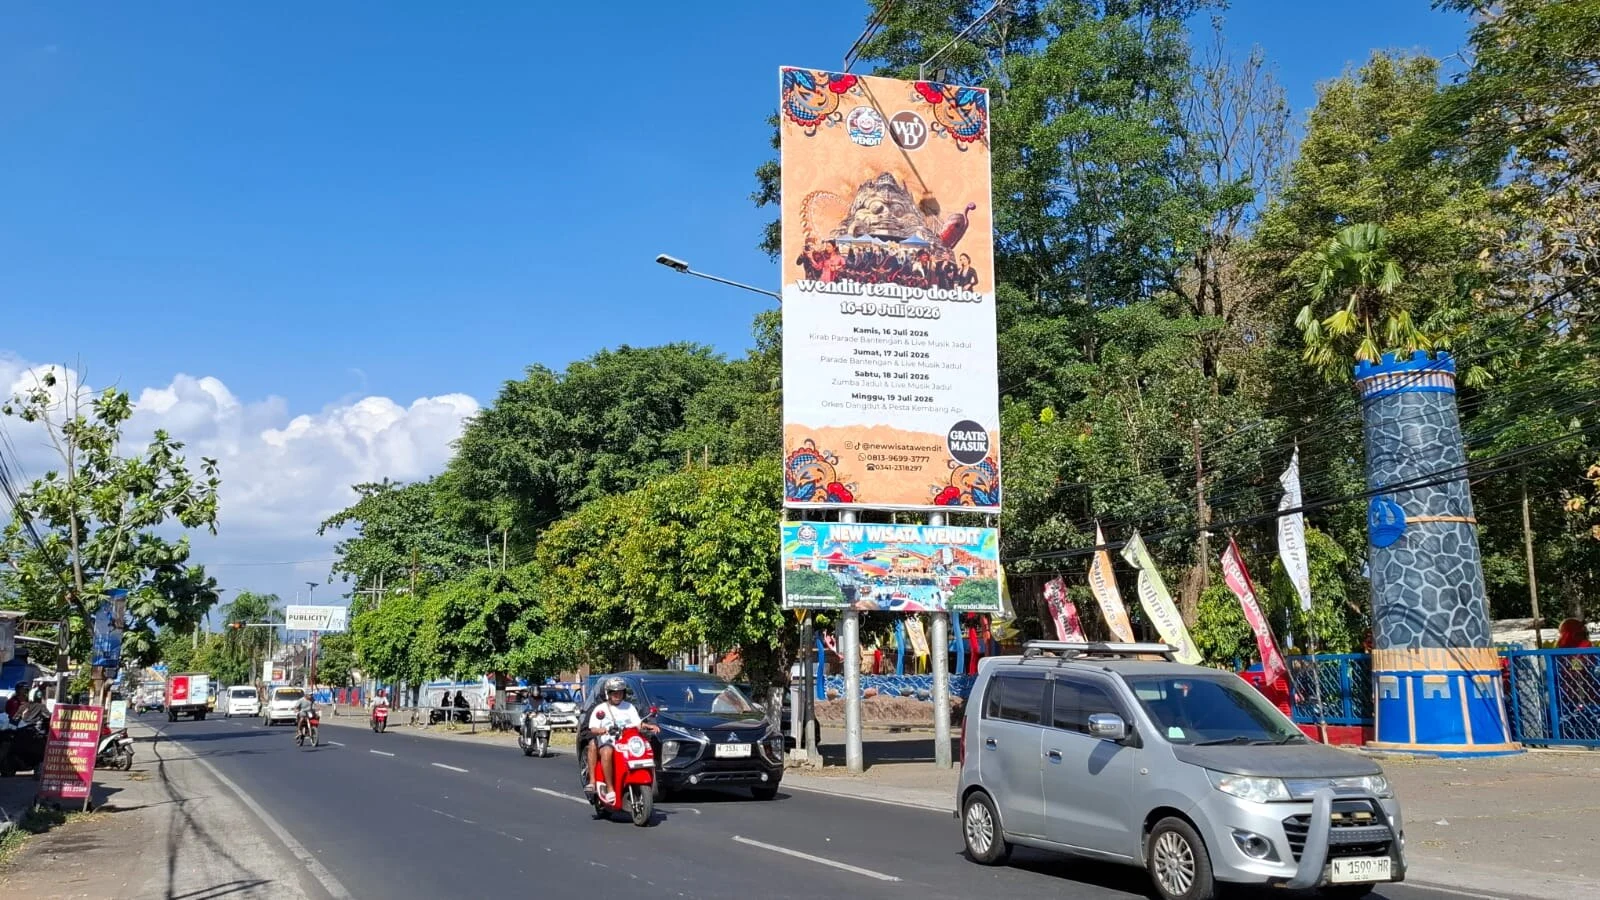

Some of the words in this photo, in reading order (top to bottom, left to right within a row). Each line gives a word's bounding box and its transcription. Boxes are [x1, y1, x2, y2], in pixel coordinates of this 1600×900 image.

[850, 135, 881, 145] WENDIT
[797, 279, 863, 295] wendit
[864, 282, 924, 302] tempo
[927, 284, 982, 303] doeloe
[840, 301, 877, 315] 16-19
[878, 303, 906, 317] Juli
[907, 306, 941, 320] 2026
[853, 327, 881, 336] Kamis,
[882, 328, 891, 336] 16
[893, 329, 908, 337] Juli
[909, 330, 929, 338] 2026
[809, 333, 830, 341] Kirab
[831, 334, 859, 343] Parade
[860, 336, 903, 346] Bantengan
[911, 339, 927, 347] Live
[928, 340, 950, 348] Musik
[951, 341, 972, 349] Jadul
[853, 349, 882, 358] Jumat,
[893, 350, 909, 358] Juli
[910, 351, 930, 359] 2026
[820, 355, 848, 364] Parade
[849, 358, 893, 368] Bantengan
[900, 360, 916, 368] Live
[917, 361, 940, 369] Musik
[941, 362, 962, 370] Jadul
[854, 370, 881, 379] Sabtu,
[893, 372, 908, 380] Juli
[909, 373, 930, 381] 2026
[832, 378, 860, 387] Zumba
[861, 379, 883, 388] Jadul
[891, 381, 906, 389] Live
[907, 382, 930, 390] Musik
[931, 383, 953, 391] Jadul
[851, 392, 885, 402] Minggu,
[897, 394, 912, 402] Juli
[914, 395, 934, 403] 2026
[821, 400, 844, 409] Orkes
[845, 402, 881, 411] Dangdut
[889, 403, 910, 412] Pesta
[950, 430, 987, 441] GRATIS
[862, 442, 942, 452] @newwisatawendit
[951, 441, 987, 452] MASUK
[830, 525, 865, 542] NEW
[867, 526, 921, 544] WISATA
[924, 528, 981, 546] WENDIT
[58, 709, 98, 721] WARUNG
[1334, 862, 1340, 874] N
[1378, 859, 1389, 873] HR
